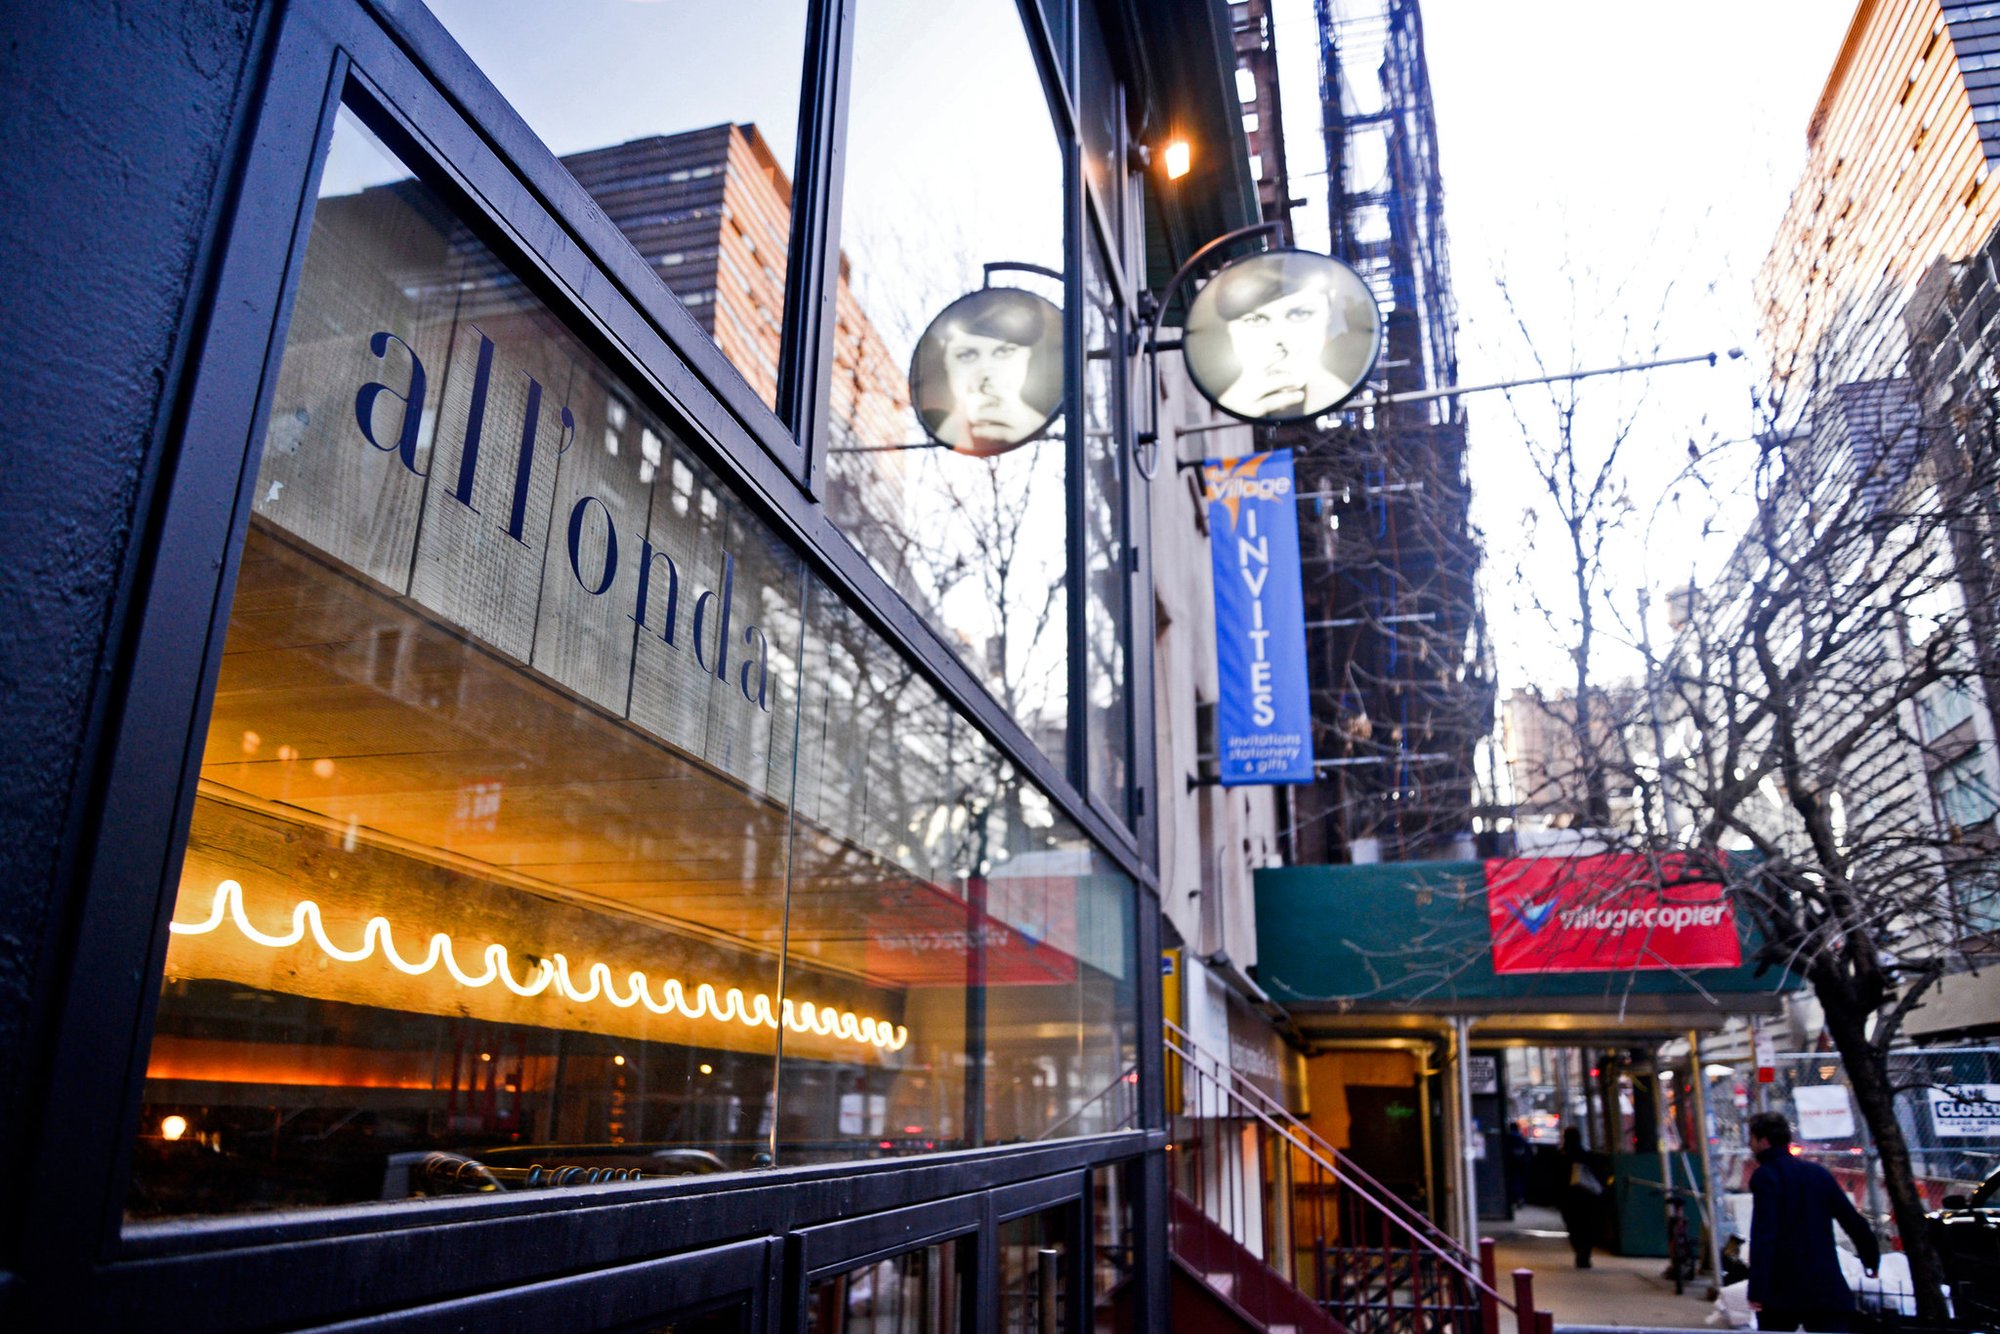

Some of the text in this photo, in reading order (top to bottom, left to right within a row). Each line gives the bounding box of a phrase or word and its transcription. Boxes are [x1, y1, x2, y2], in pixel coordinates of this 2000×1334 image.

[355, 324, 771, 713] all'onda
[1238, 508, 1275, 728] INVITES
[1560, 903, 1728, 936] villagecopier
